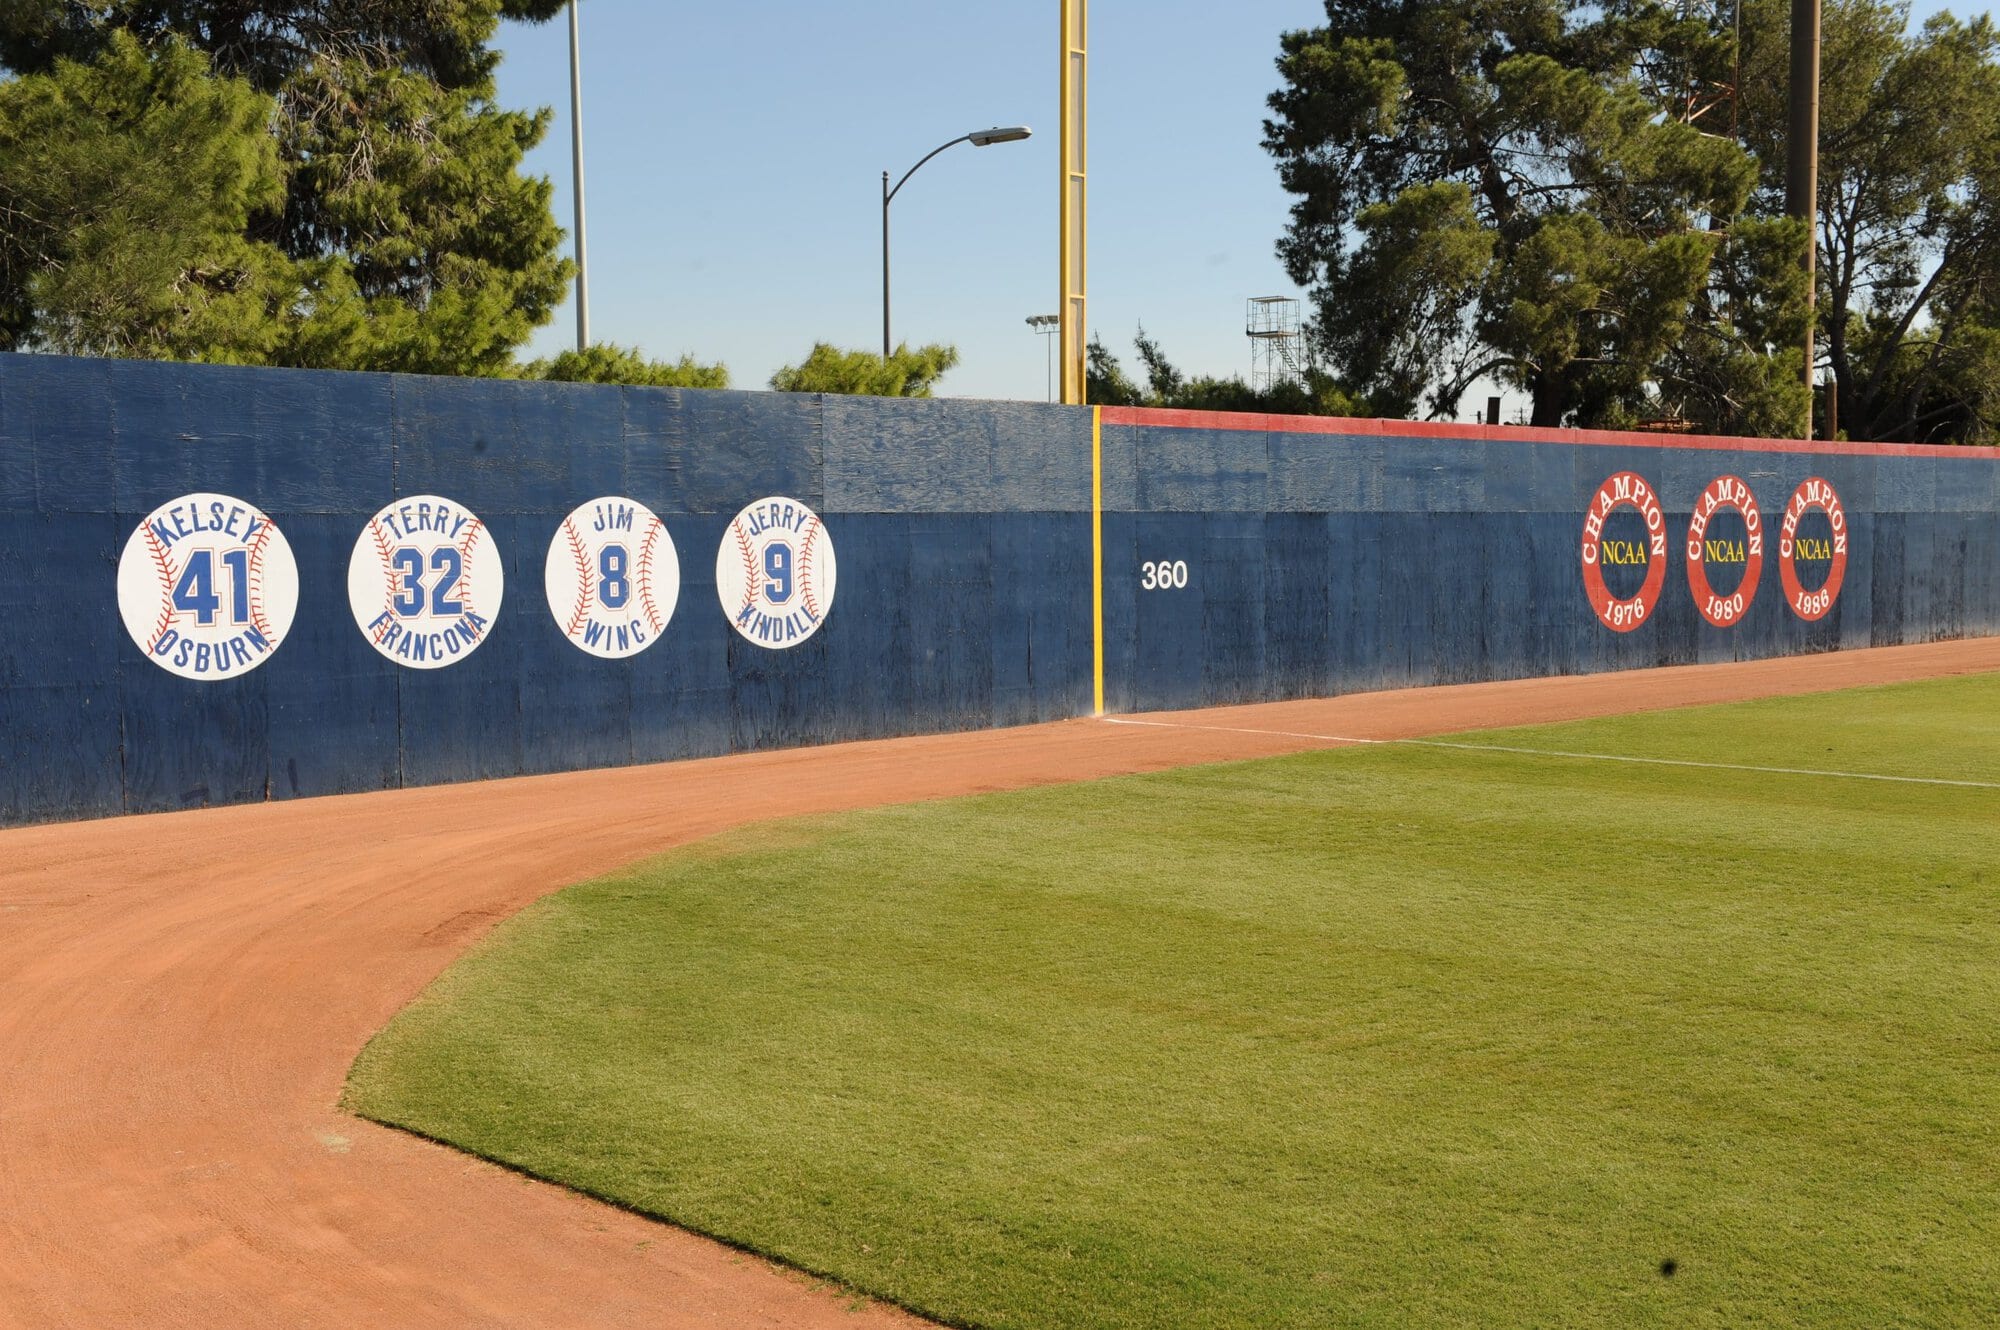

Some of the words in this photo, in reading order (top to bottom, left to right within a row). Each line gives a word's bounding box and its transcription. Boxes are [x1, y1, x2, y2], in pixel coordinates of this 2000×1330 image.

[150, 502, 263, 548] KELSEY
[382, 503, 468, 540] TERRY
[594, 503, 635, 533] JIM
[748, 503, 808, 537] JERRY
[1583, 475, 1665, 564] CHAMPION
[1688, 478, 1762, 561] CHAMPION
[1780, 480, 1846, 558] CHAMPION
[1602, 540, 1647, 564] NCAA
[1705, 540, 1745, 563] NCAA
[1795, 538, 1831, 560] NCAA
[170, 549, 250, 625] 41
[391, 547, 464, 618] 32
[598, 544, 631, 610] 8
[763, 541, 793, 604] 9
[1141, 560, 1188, 590] 360
[1604, 597, 1645, 626] 1976
[1705, 593, 1743, 620] 1980
[1796, 588, 1830, 615] 1986
[368, 610, 487, 662] FRANCONA
[584, 618, 646, 651] WING
[737, 602, 820, 642] KINDALL
[154, 624, 270, 673] OSBURN
